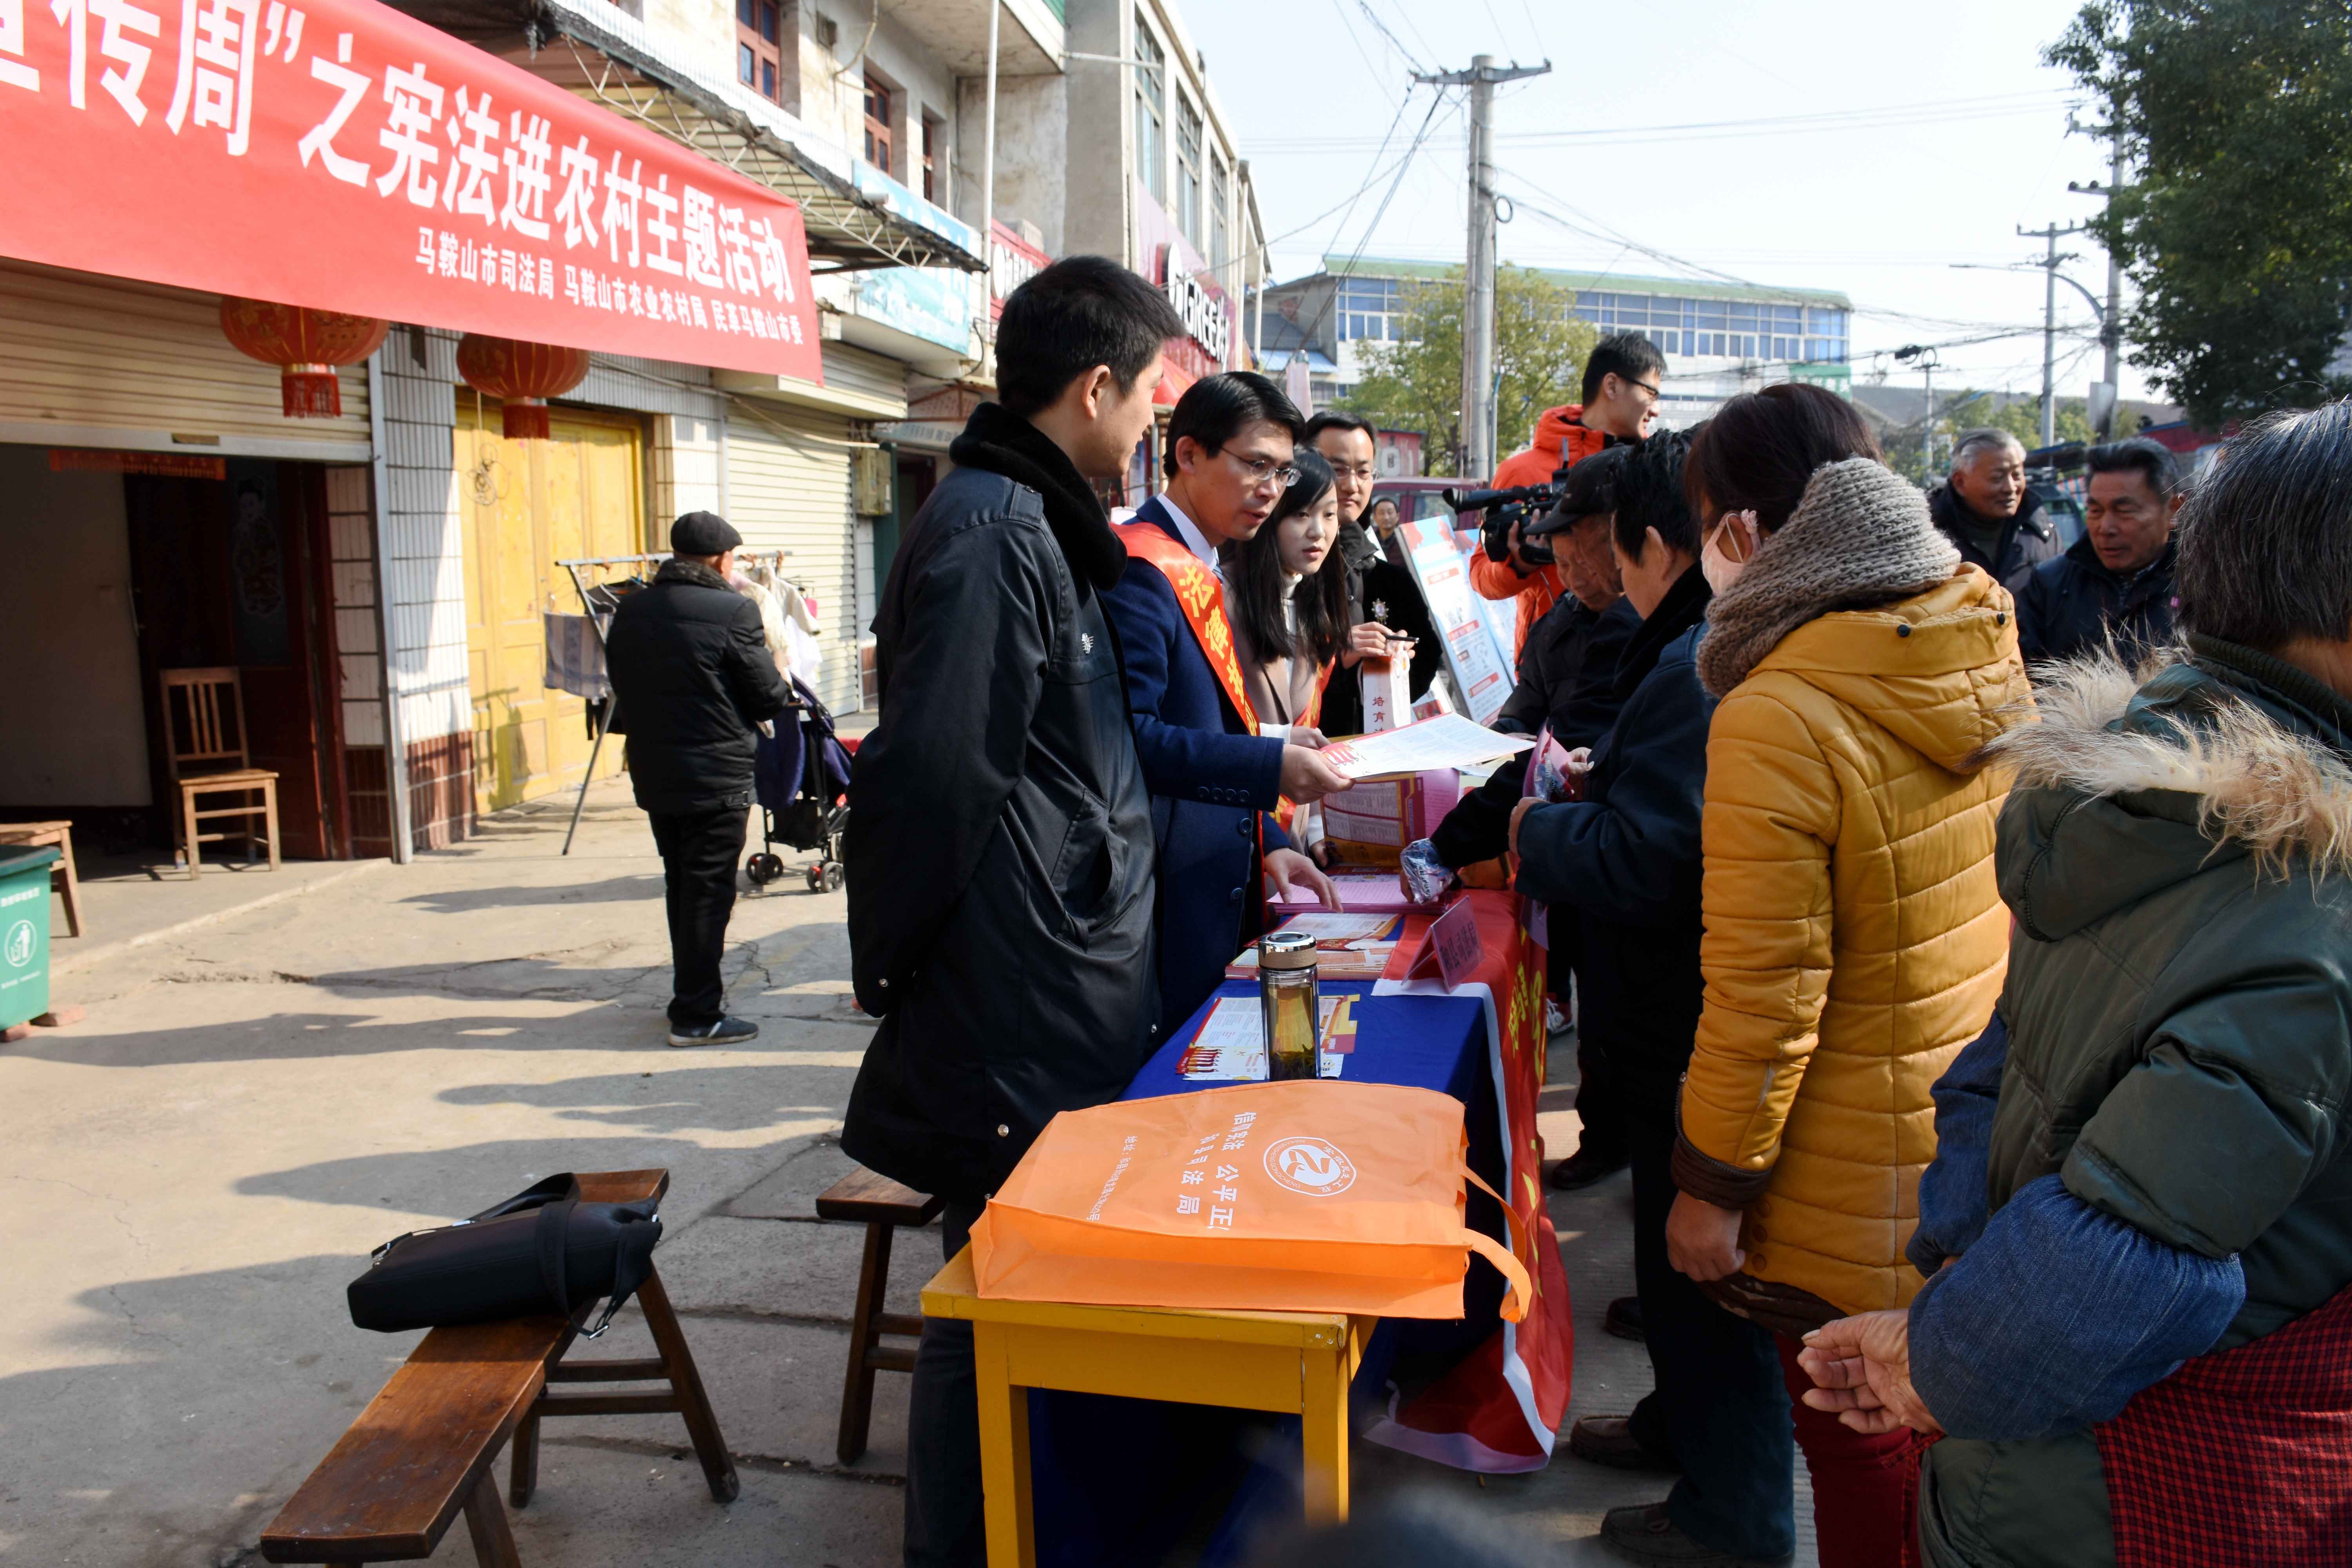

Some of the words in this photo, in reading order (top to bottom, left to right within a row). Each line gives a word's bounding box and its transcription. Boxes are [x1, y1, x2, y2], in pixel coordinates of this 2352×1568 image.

[416, 226, 554, 299] 马鞍山市司法局
[564, 264, 708, 329] 马鞍山市农业农村局
[711, 299, 803, 345] 民革马鞍山市委
[1207, 1164, 1239, 1230] 公平正
